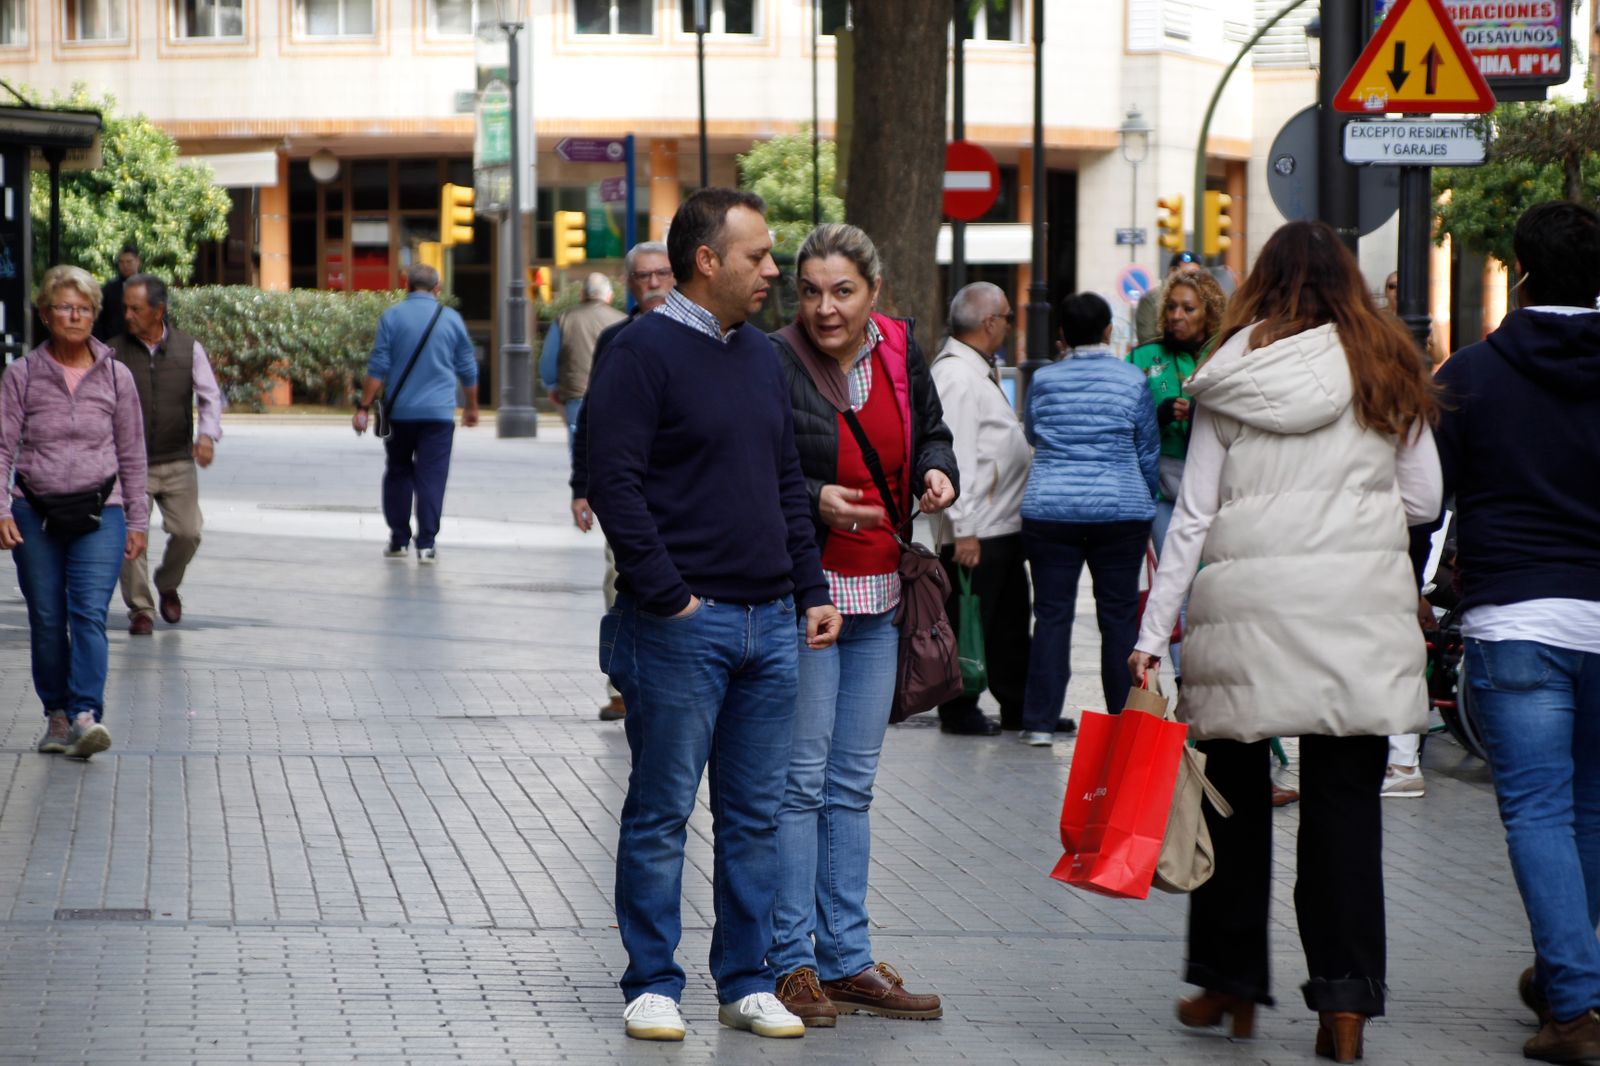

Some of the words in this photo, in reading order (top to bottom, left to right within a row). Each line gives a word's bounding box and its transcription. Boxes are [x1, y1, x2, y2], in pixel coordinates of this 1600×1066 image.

[1466, 28, 1554, 44] DESAYUNOS
[1351, 126, 1406, 138] EXCEPTO
[1409, 126, 1483, 139] RESIDENTE
[1384, 143, 1391, 155] Y
[1394, 143, 1447, 156] GARAJES
